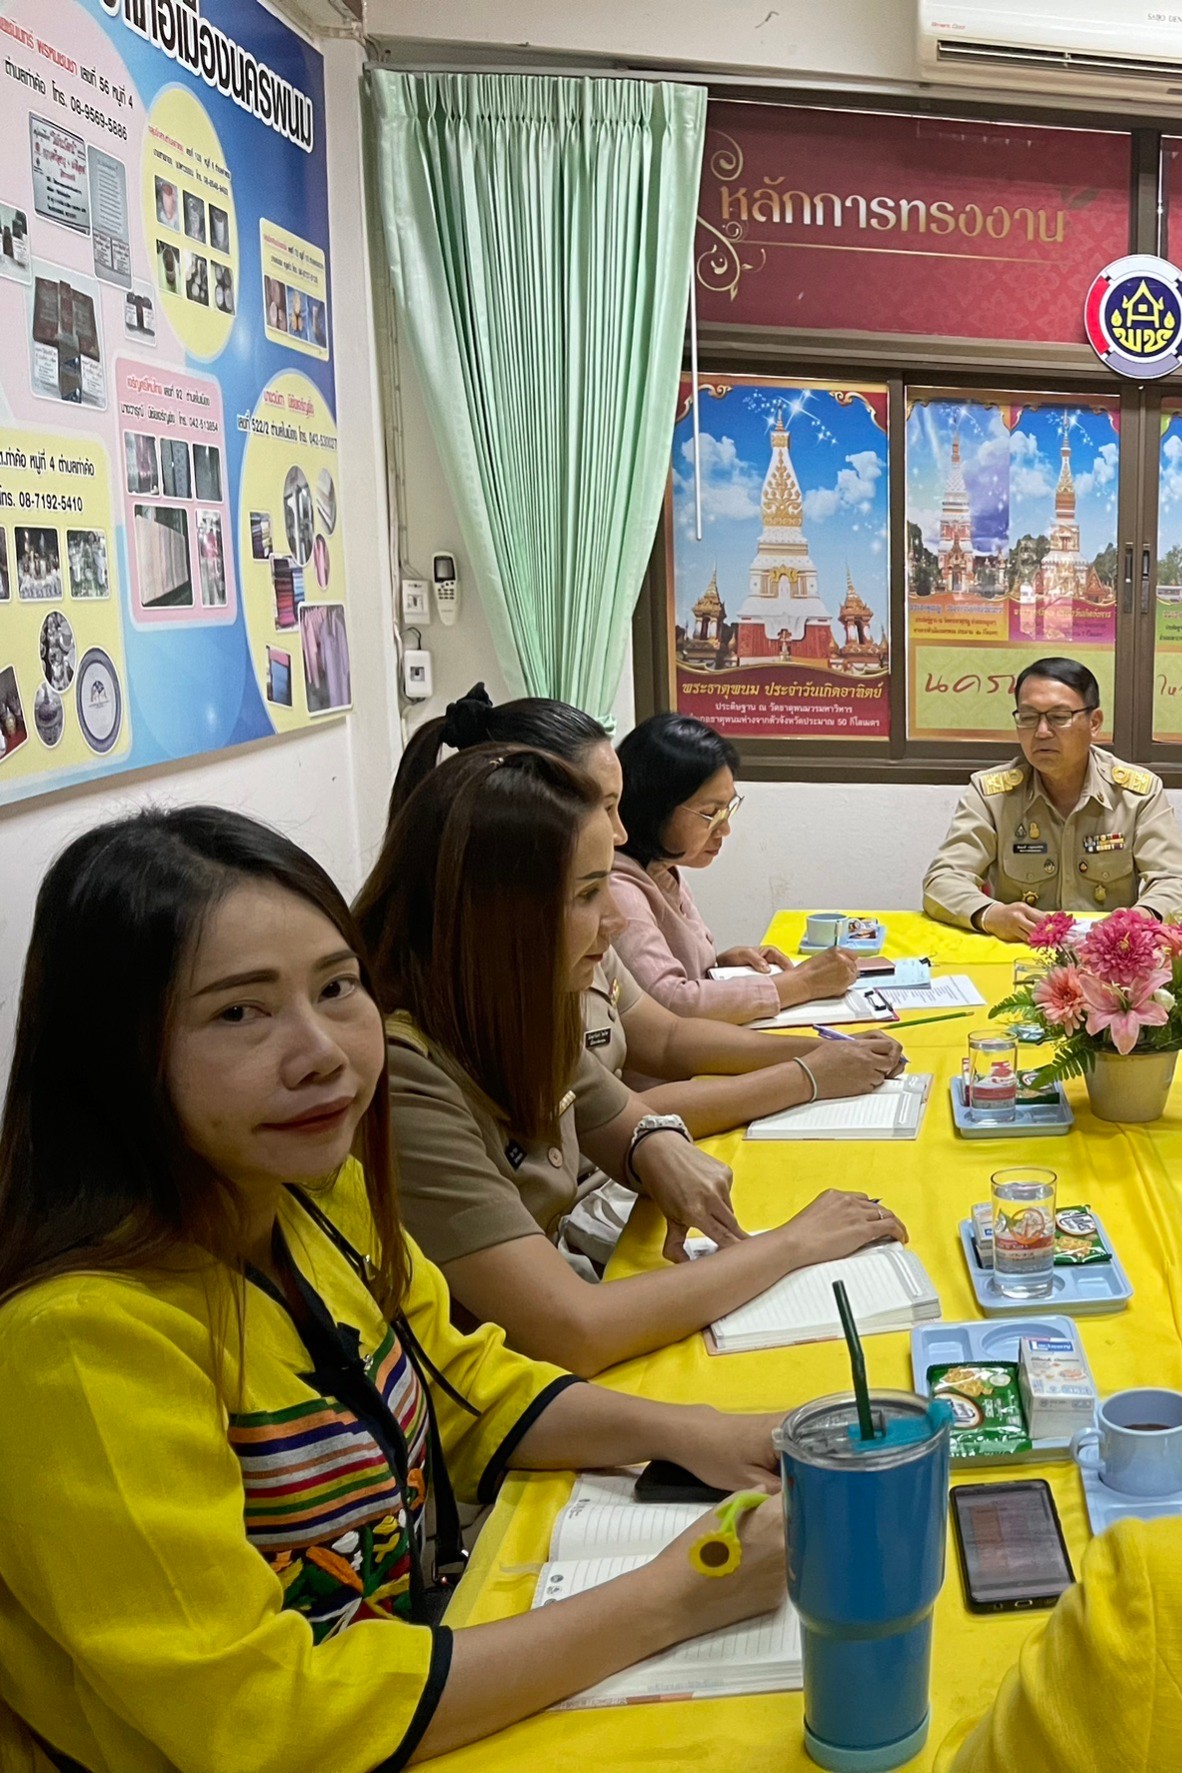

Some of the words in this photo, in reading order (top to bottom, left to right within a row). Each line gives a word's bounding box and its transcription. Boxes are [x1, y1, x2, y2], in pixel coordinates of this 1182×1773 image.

[99, 0, 313, 152] ภอเมืองนครพนม
[99, 76, 110, 96] 56
[718, 175, 1066, 244] หลักการทรงงาน
[49, 456, 55, 472] 4
[19, 491, 83, 512] 08-7192-5410
[682, 682, 759, 700] พระธาตุพนม
[765, 681, 884, 699] ประจำวันเกิดอาทิตย์
